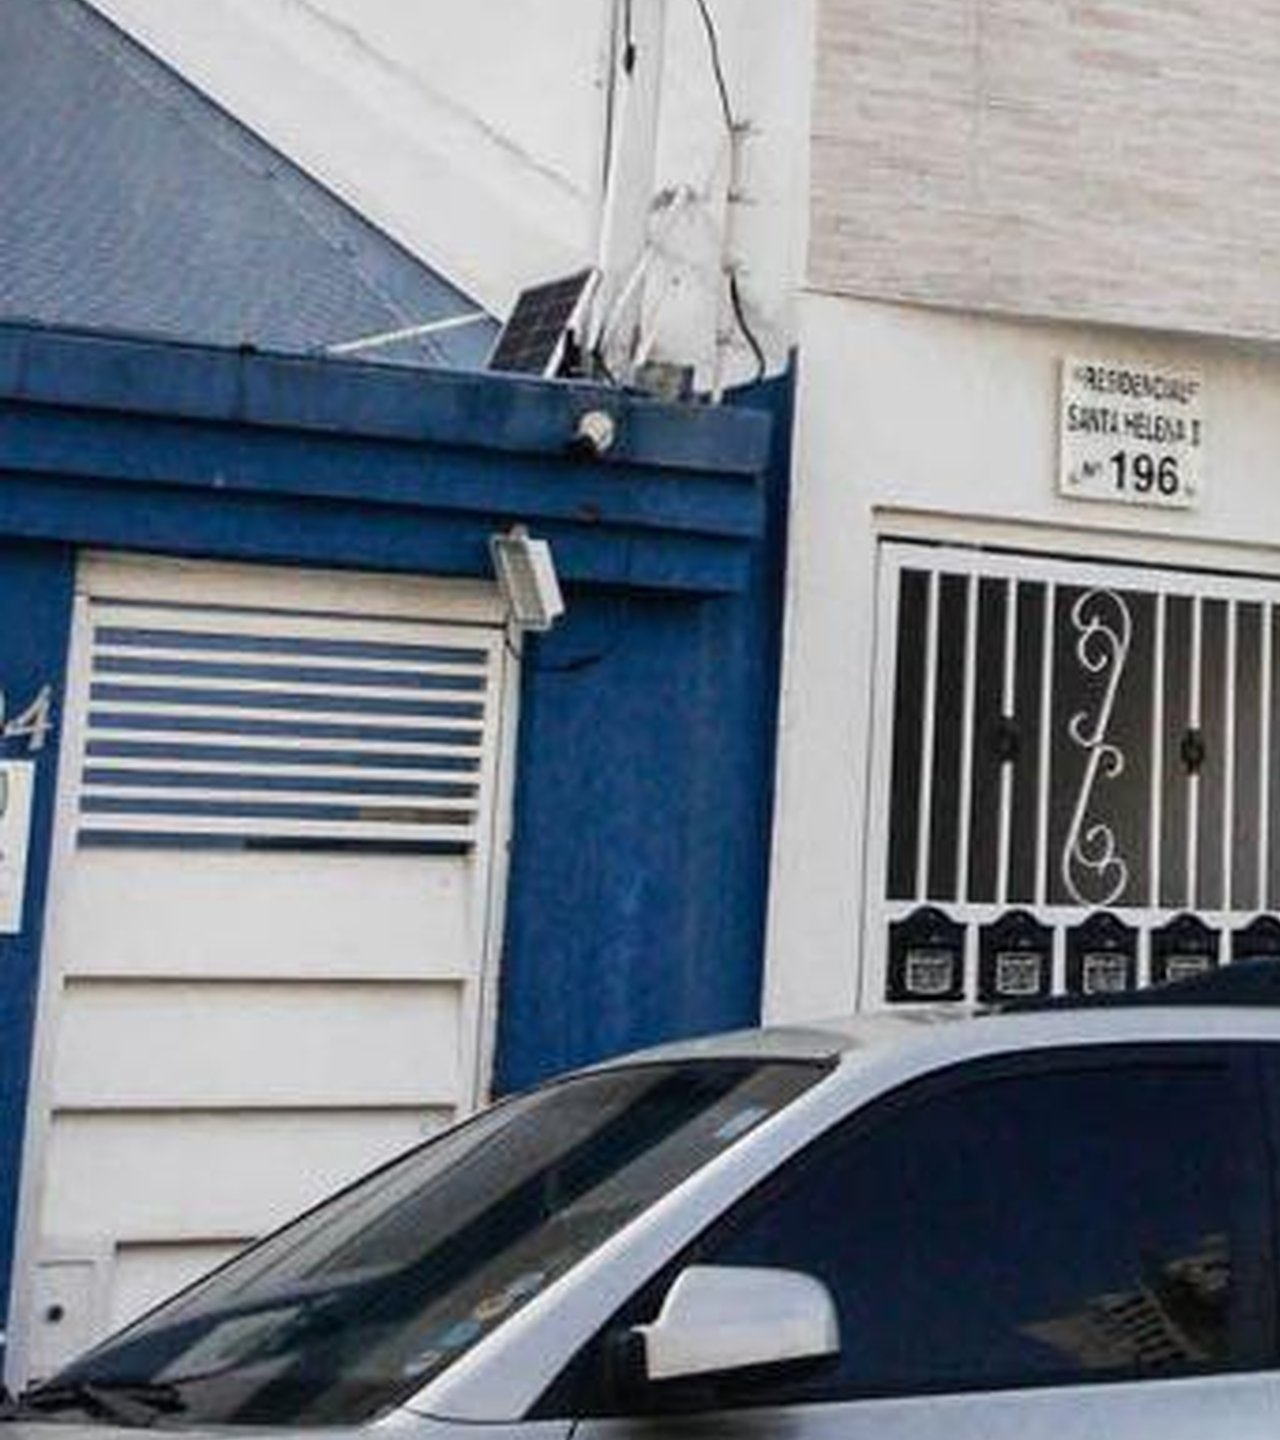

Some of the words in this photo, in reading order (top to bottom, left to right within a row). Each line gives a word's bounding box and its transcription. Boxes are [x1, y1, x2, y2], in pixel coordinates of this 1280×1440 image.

[1067, 403, 1119, 434] SANTA
[1123, 410, 1186, 443] HELENA
[1109, 450, 1179, 495] 196
[0, 684, 53, 751] 4
